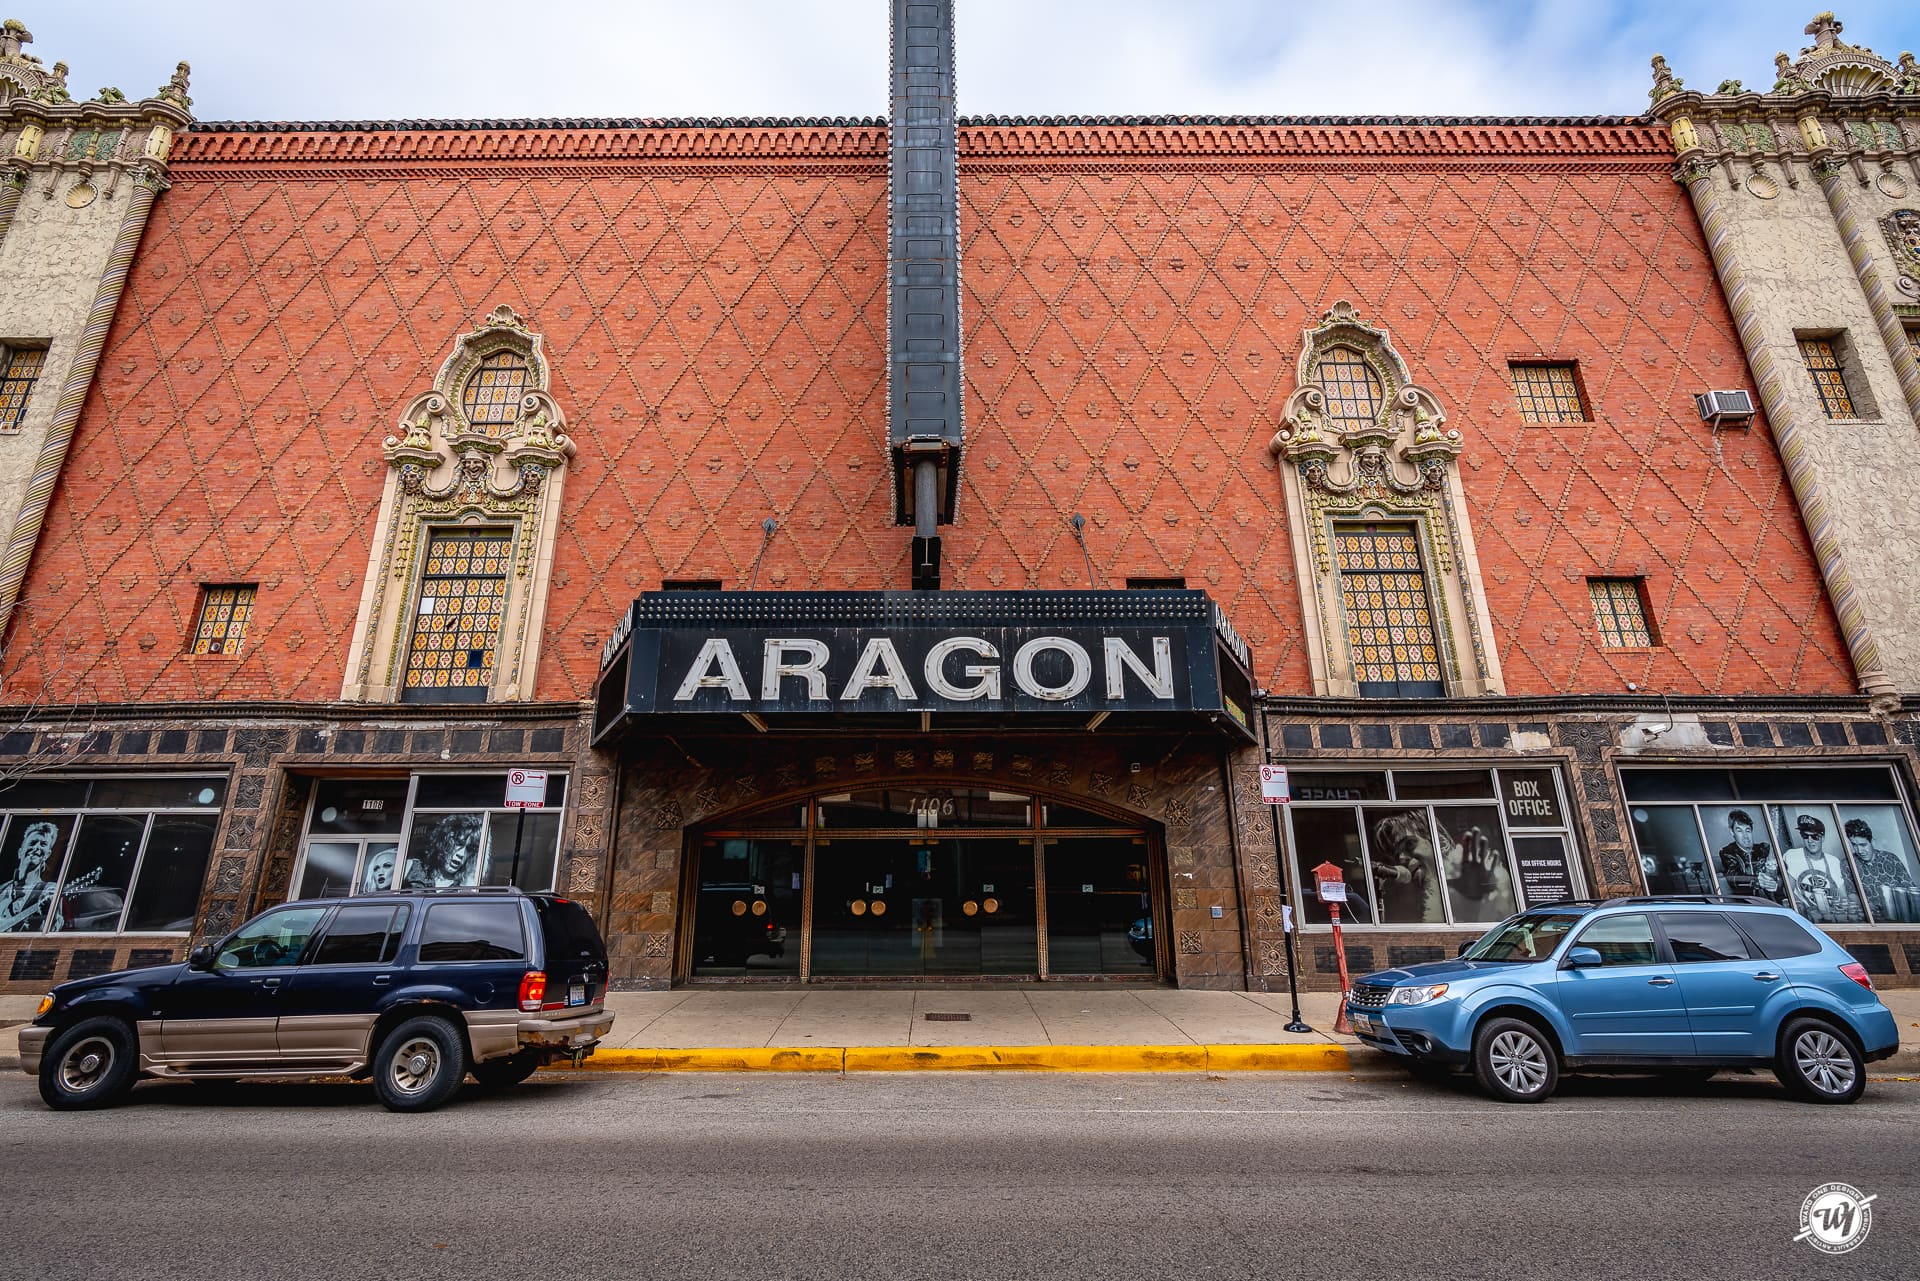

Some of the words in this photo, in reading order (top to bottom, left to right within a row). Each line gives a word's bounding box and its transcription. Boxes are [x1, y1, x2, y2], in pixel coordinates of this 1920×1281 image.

[672, 636, 1175, 701] ARAGON
[1513, 780, 1541, 797] BOX
[907, 797, 954, 815] 1106
[1508, 799, 1553, 816] OFFICE
